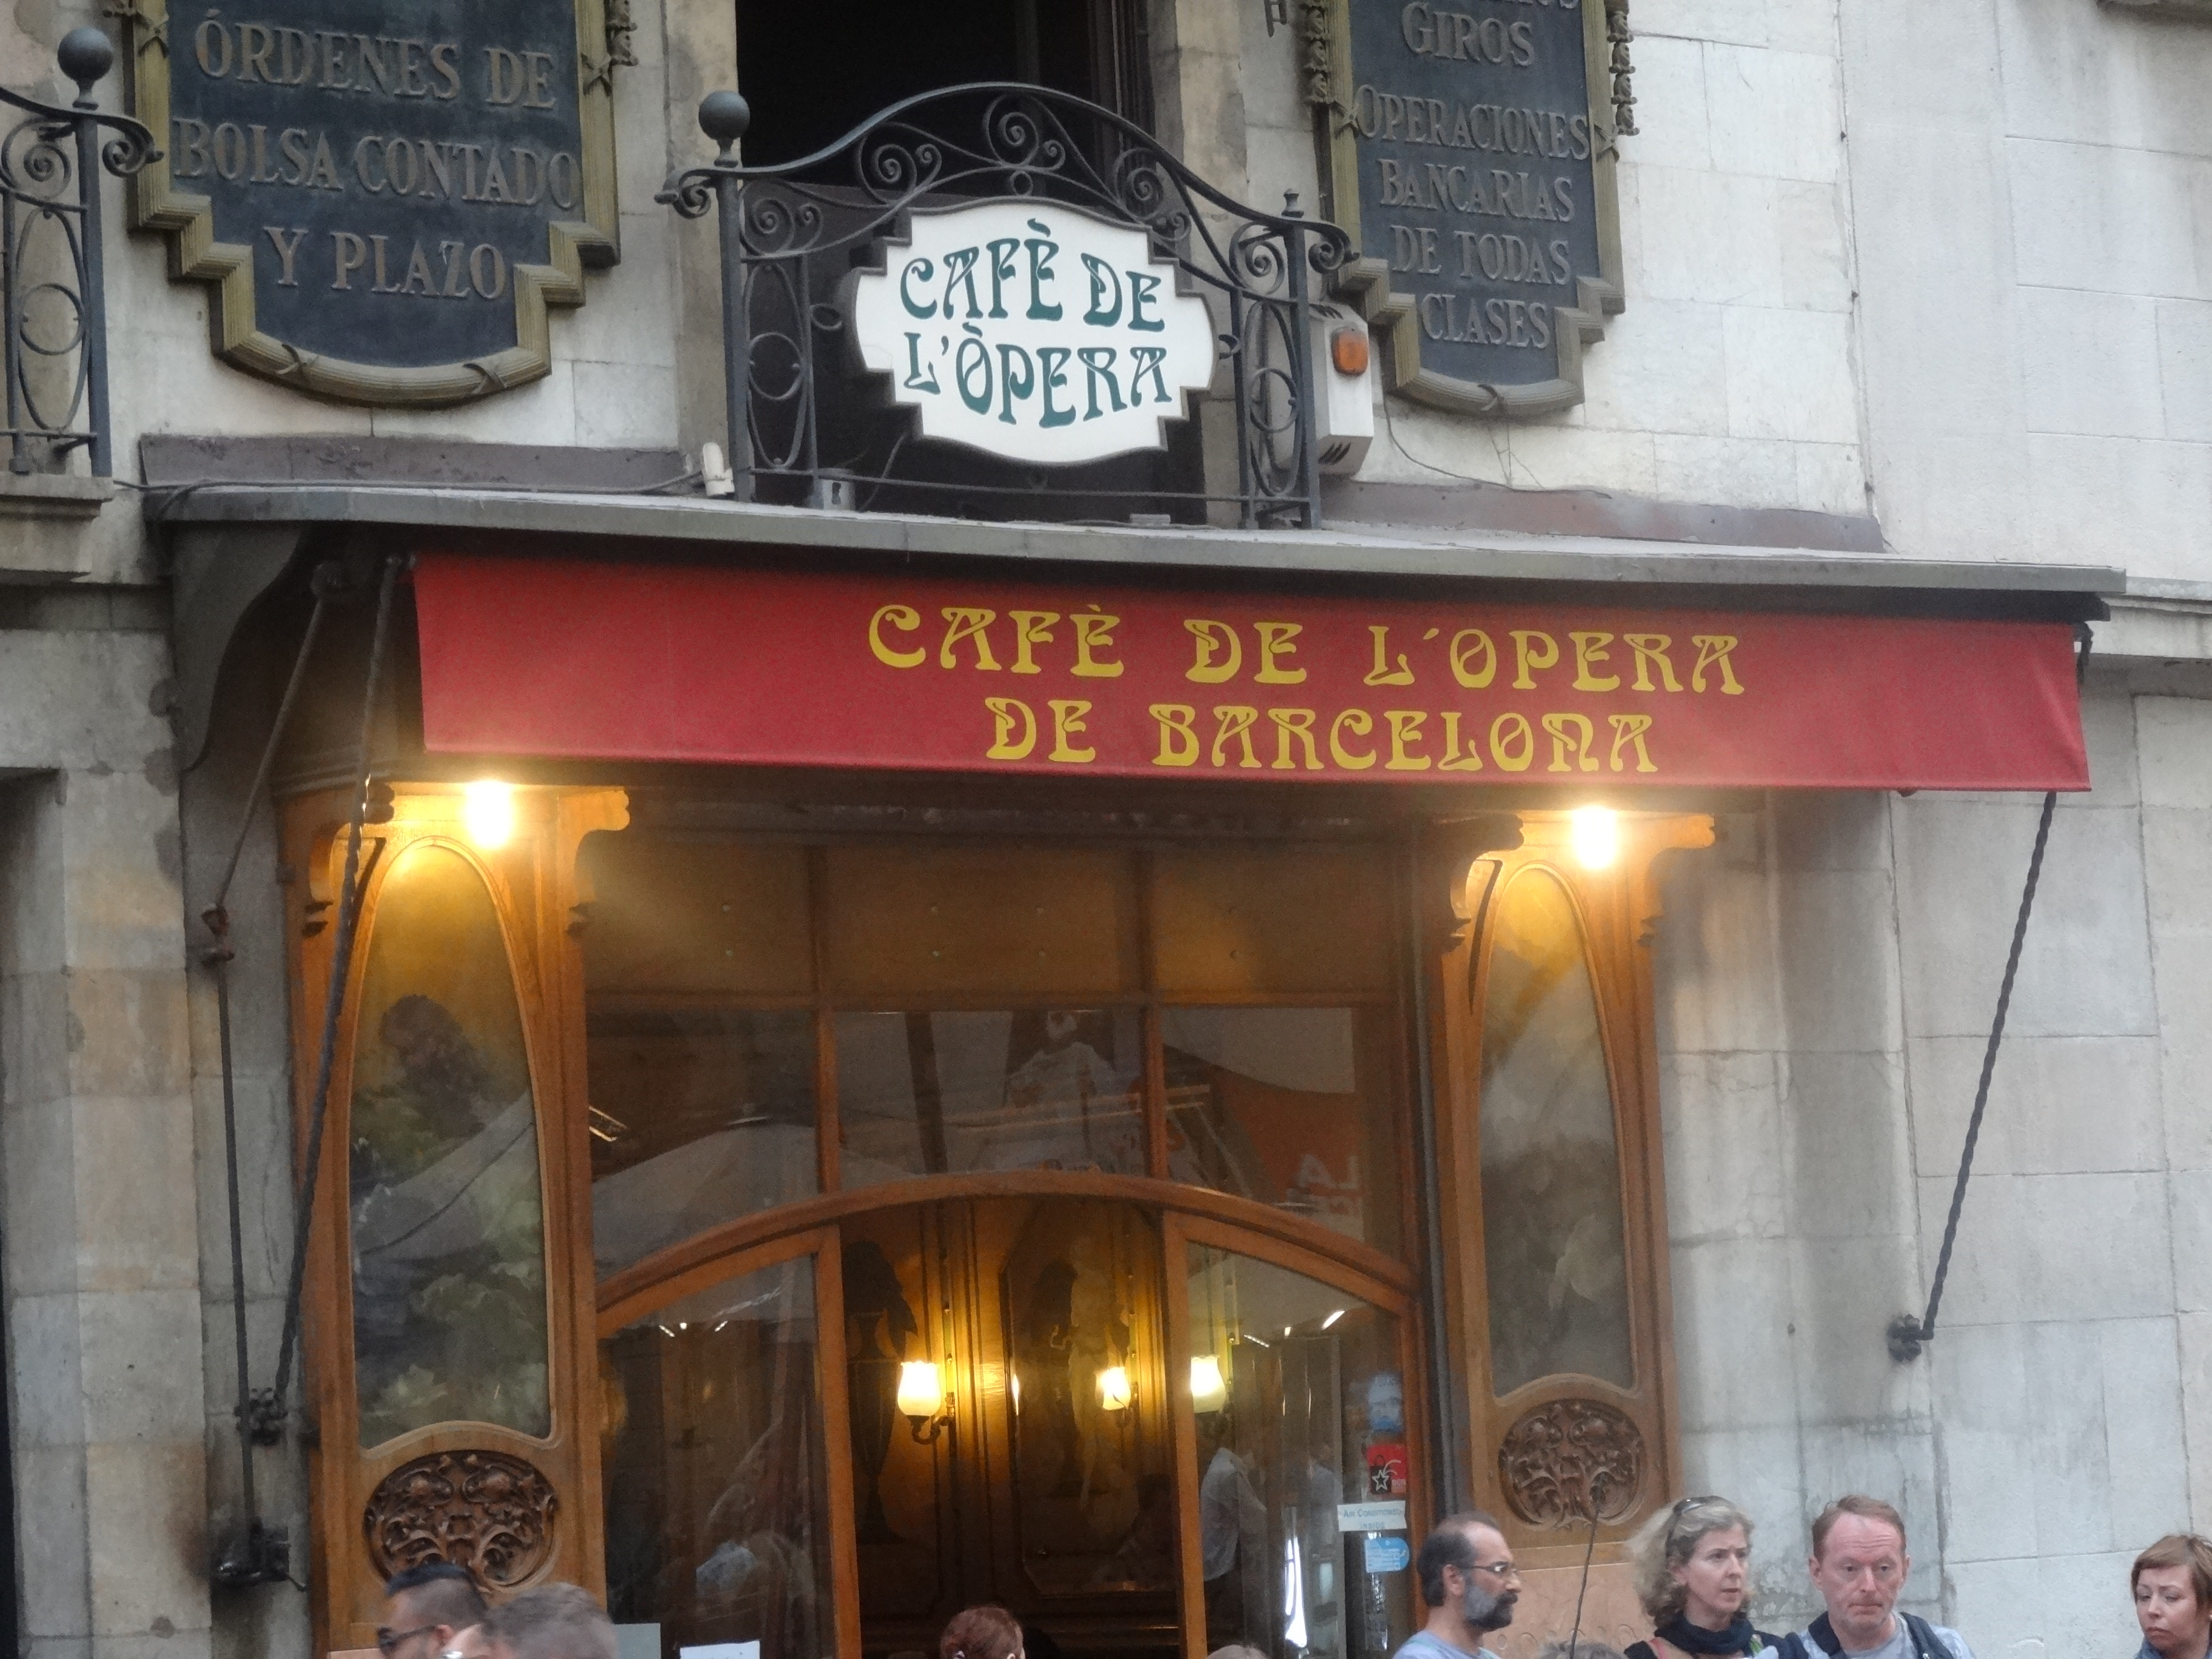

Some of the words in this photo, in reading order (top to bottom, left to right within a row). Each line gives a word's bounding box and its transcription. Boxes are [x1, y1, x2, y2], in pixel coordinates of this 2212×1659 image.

[195, 8, 461, 102] ÓRDENES
[486, 46, 557, 110] DE
[1401, 2, 1535, 67] GIROS
[1354, 84, 1590, 161] OPERACIONES
[172, 117, 344, 191] BOLSA
[354, 135, 581, 210] CONTADO
[1376, 158, 1575, 222] BANCARIAS
[263, 226, 309, 287] Y
[330, 230, 508, 300] PLAZO
[900, 218, 1064, 322] CAFÈ
[1081, 252, 1165, 333] DE
[1390, 225, 1443, 275] DE
[1454, 231, 1572, 286] TODAS
[1421, 293, 1550, 349] CLASES
[903, 321, 1173, 429] L'ÒPERA
[868, 604, 1125, 677] CAFÈ
[1183, 619, 1307, 684] DE
[984, 697, 1096, 763] DE
[1148, 703, 1658, 773] BARCELONA
